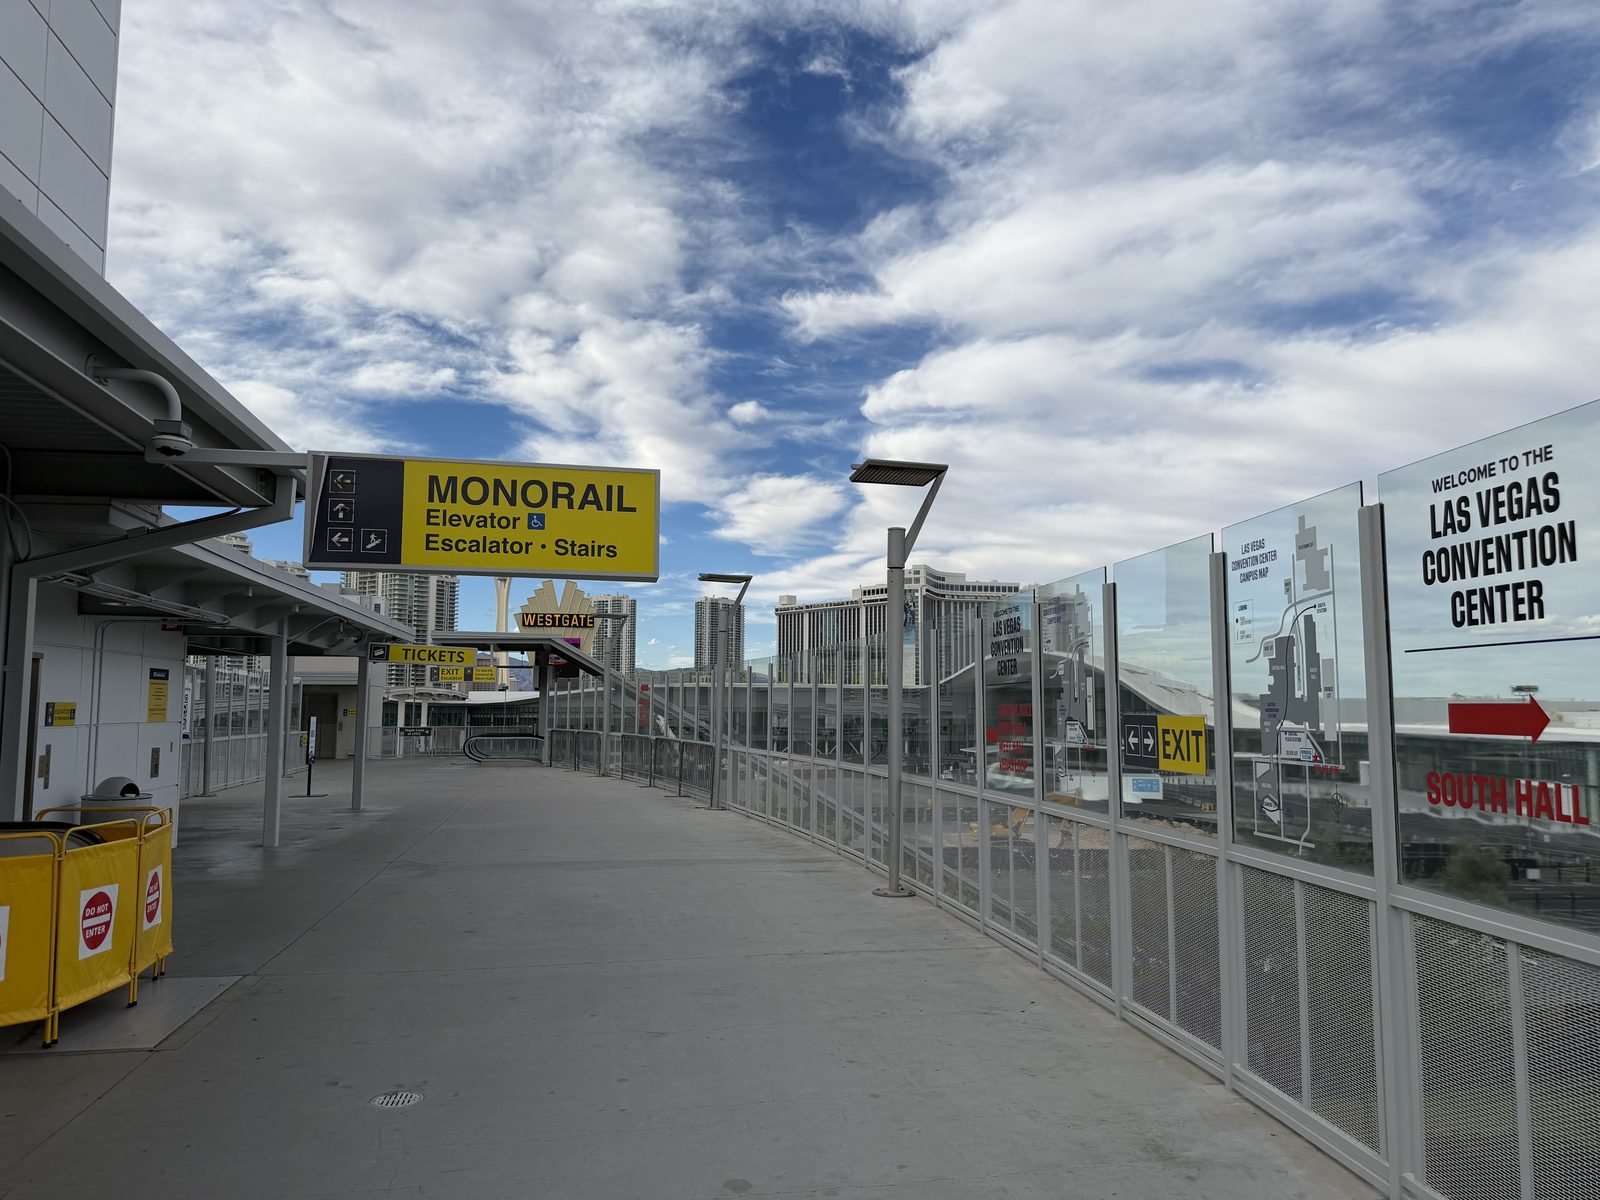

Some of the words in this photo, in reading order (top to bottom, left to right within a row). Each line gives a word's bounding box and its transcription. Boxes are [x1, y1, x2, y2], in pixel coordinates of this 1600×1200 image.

[1432, 462, 1496, 493] WELCOME
[1499, 455, 1519, 474] TO
[1522, 444, 1553, 466] THE
[428, 475, 637, 512] MONORAIL
[1430, 496, 1470, 540] LAS
[1476, 472, 1560, 528] VEGAS
[426, 509, 521, 530] Elevator
[425, 533, 533, 555] Escalator
[554, 538, 618, 558] Stairs
[1241, 542, 1250, 554] LAS
[1250, 538, 1265, 552] VEGAS
[1422, 520, 1577, 586] CONVENTION
[1232, 554, 1258, 571] CONVENTION
[1258, 550, 1278, 564] CENTER
[1240, 570, 1258, 584] CAMPUS
[1258, 566, 1268, 579] MAP
[1451, 580, 1544, 628] CENTER
[523, 614, 593, 626] WESTGATE
[993, 620, 1002, 638] LAS
[1003, 616, 1020, 635] VEGAS
[402, 648, 464, 662] TICKETS
[991, 636, 1024, 657] CONVENTION
[997, 658, 1018, 676] CENTER
[1162, 728, 1203, 763] EXIT
[1426, 770, 1508, 814] SOUTH
[1514, 779, 1590, 825] HALL
[86, 906, 96, 917] DO
[96, 903, 109, 914] NOT
[86, 925, 106, 938] ENTER
